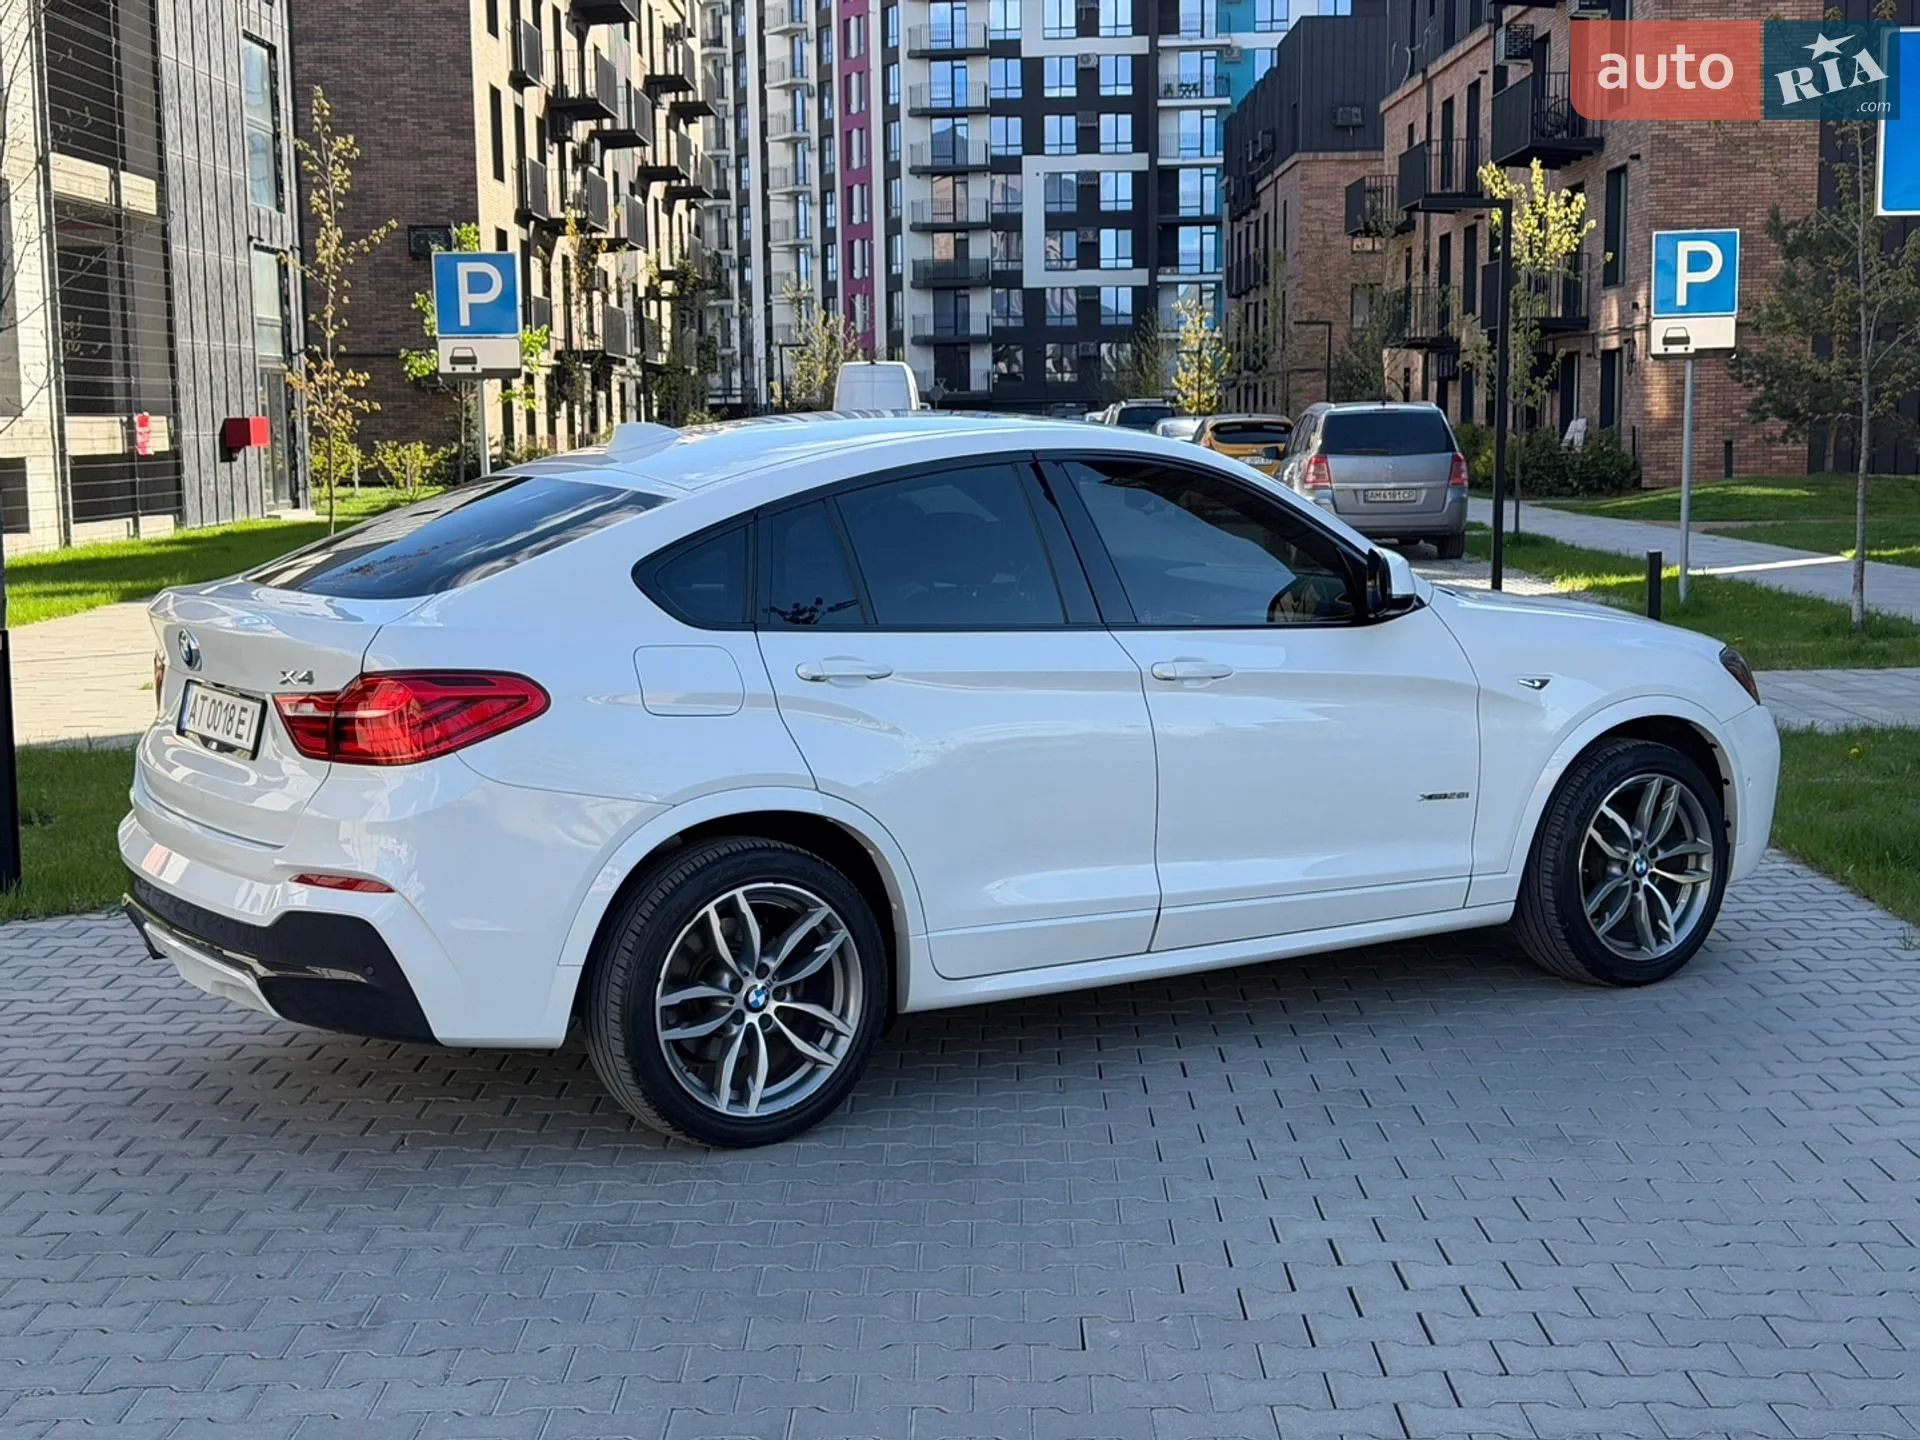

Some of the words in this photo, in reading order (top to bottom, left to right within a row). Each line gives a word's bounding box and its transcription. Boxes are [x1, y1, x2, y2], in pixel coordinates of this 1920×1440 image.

[457, 262, 503, 327] P
[1676, 240, 1723, 306] P
[280, 670, 315, 685] X4
